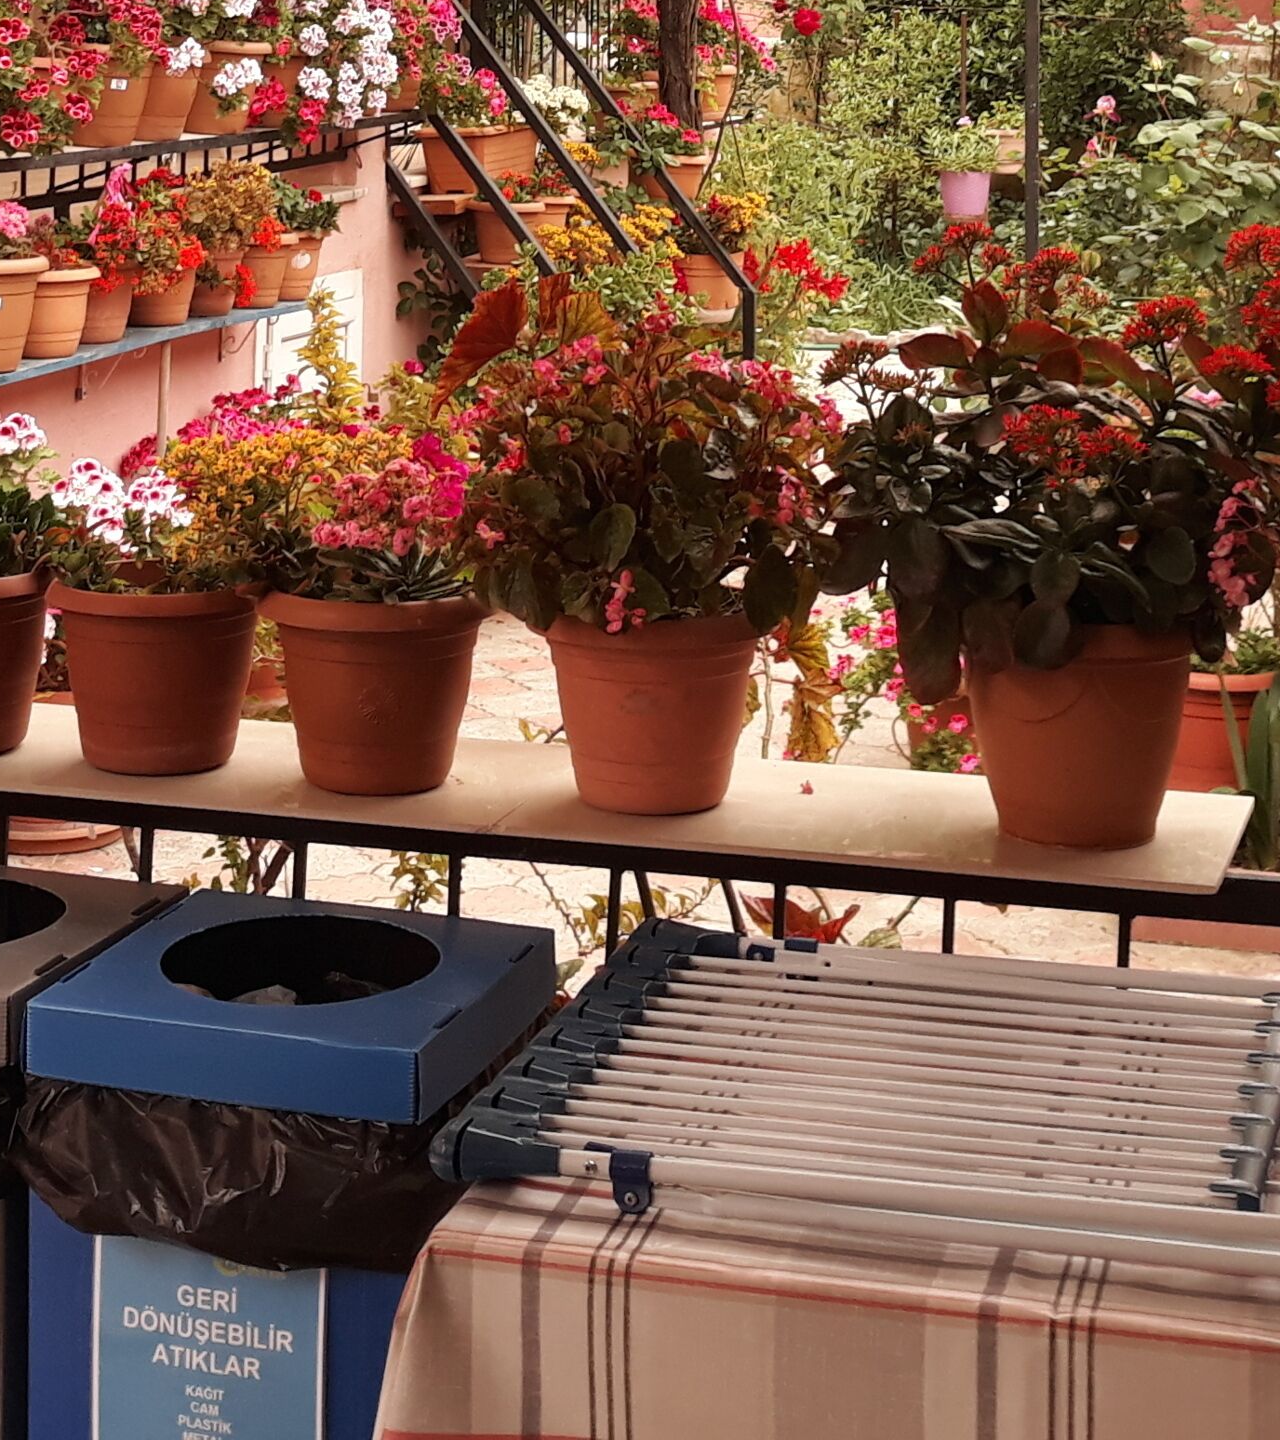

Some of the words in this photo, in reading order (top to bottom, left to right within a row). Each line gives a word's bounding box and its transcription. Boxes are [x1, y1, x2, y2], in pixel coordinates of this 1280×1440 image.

[176, 1284, 238, 1314] GERİ
[123, 1305, 294, 1354] DÖNÜŞEBİLİR
[152, 1344, 261, 1380] ATIKLAR
[190, 1401, 220, 1416] CAM
